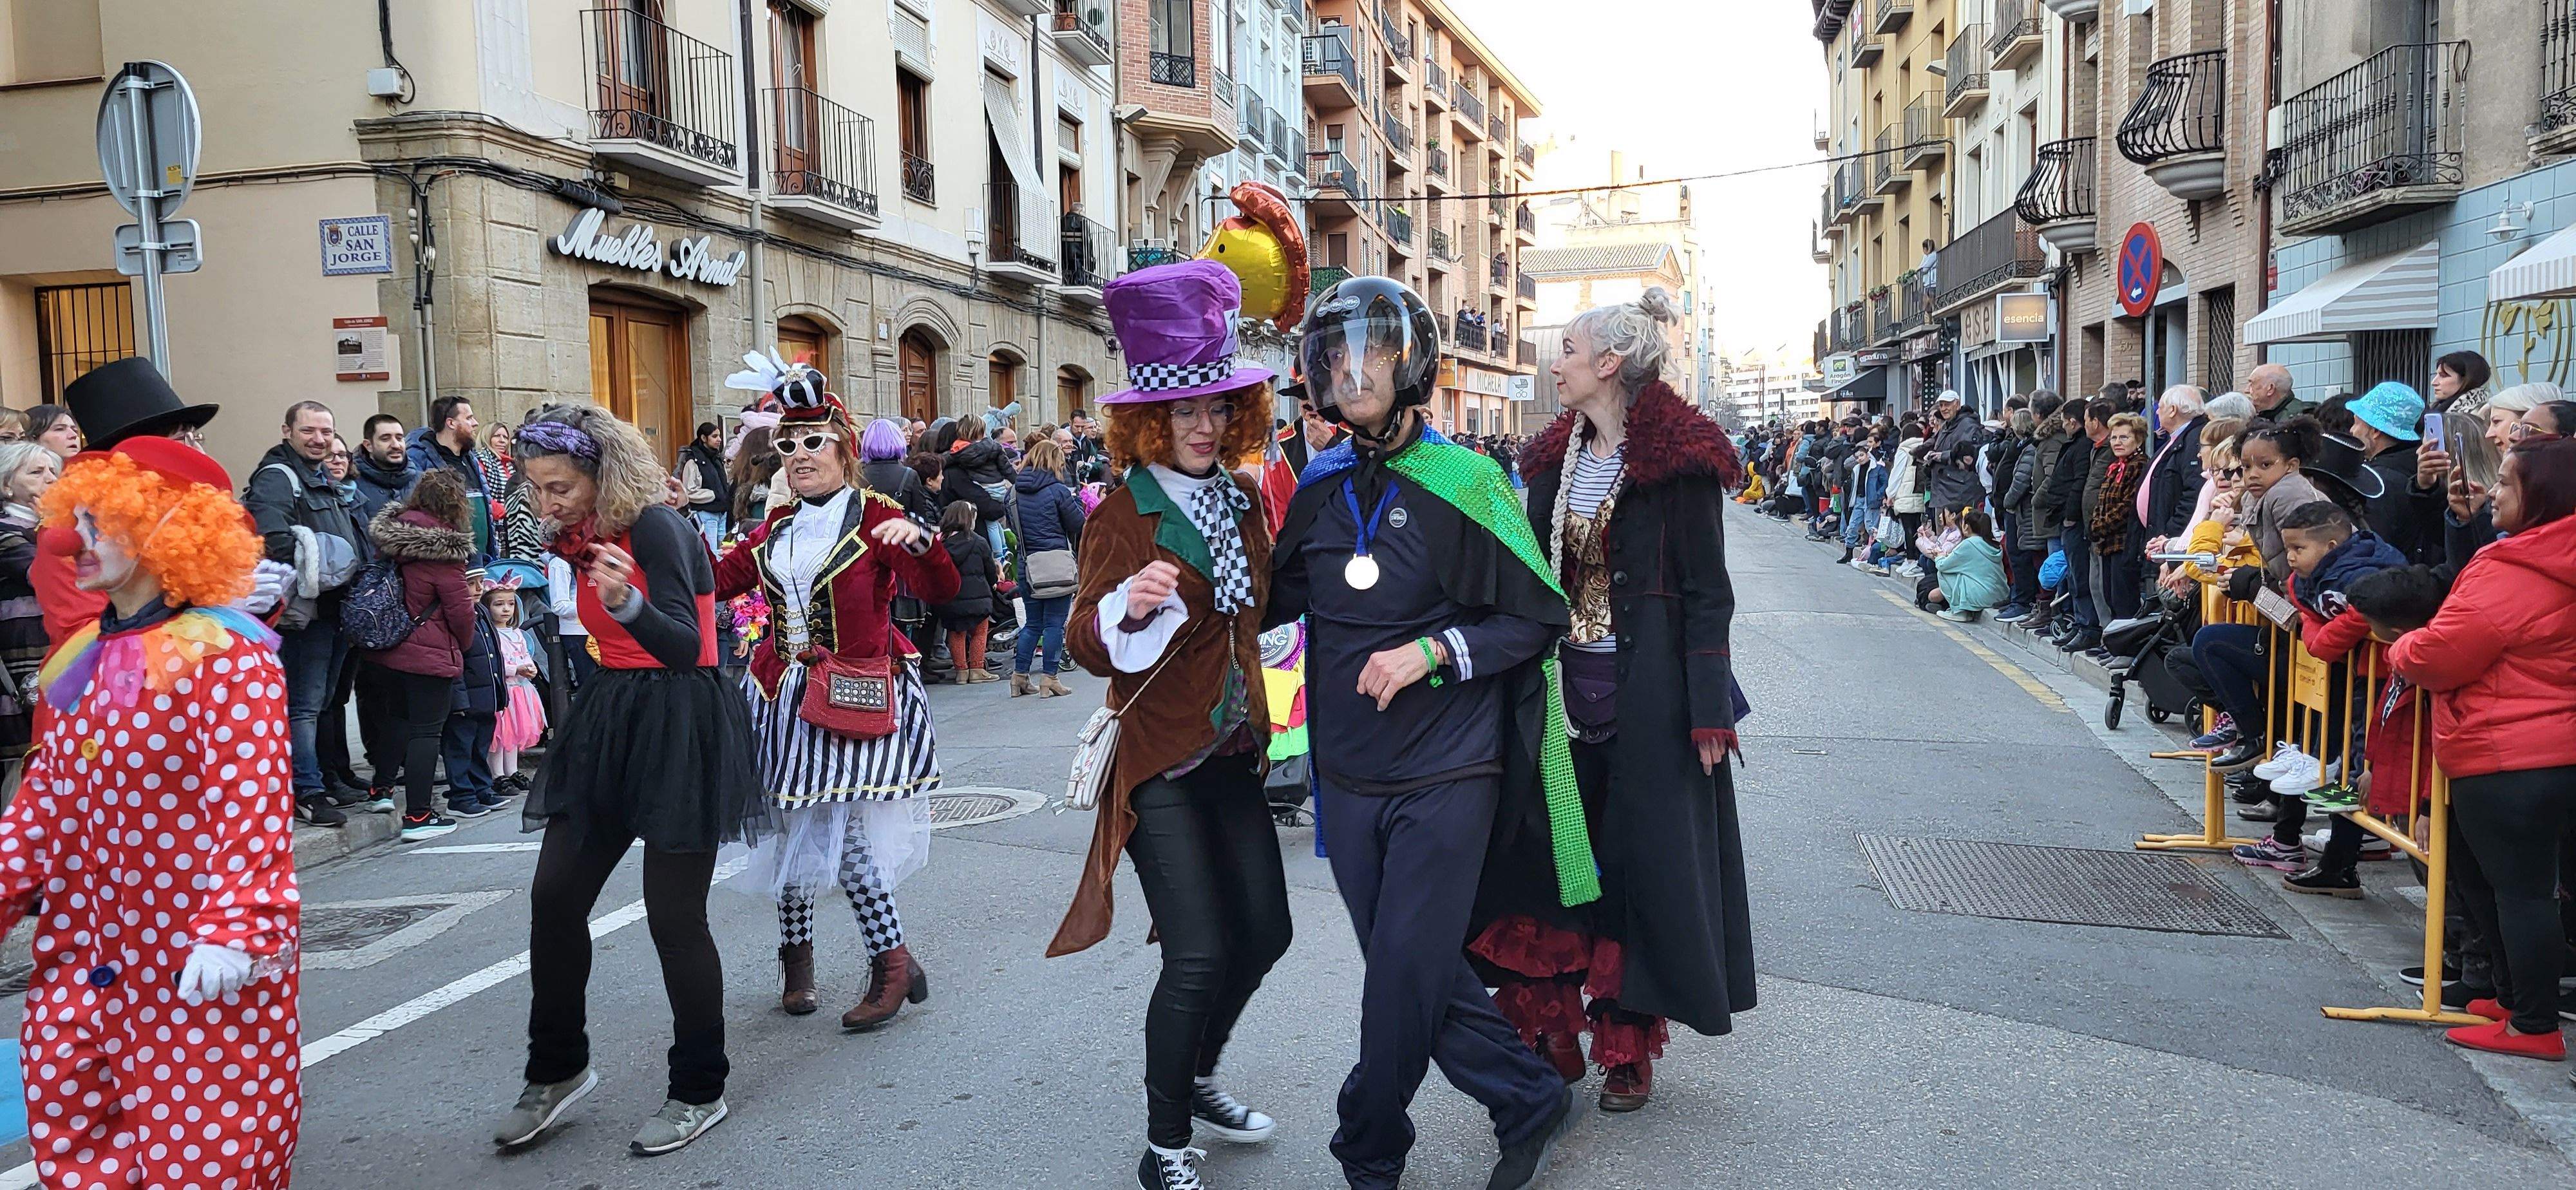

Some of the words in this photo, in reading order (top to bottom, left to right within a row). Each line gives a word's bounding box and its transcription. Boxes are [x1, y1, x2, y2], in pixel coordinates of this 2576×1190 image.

[348, 225, 379, 237] CALLE
[345, 239, 374, 251] SAN
[557, 207, 662, 273] Muebles
[670, 235, 746, 287] Arnal
[330, 252, 382, 266] JORGE
[2003, 312, 2044, 324] esencia
[1477, 372, 1501, 393] MICAELA
